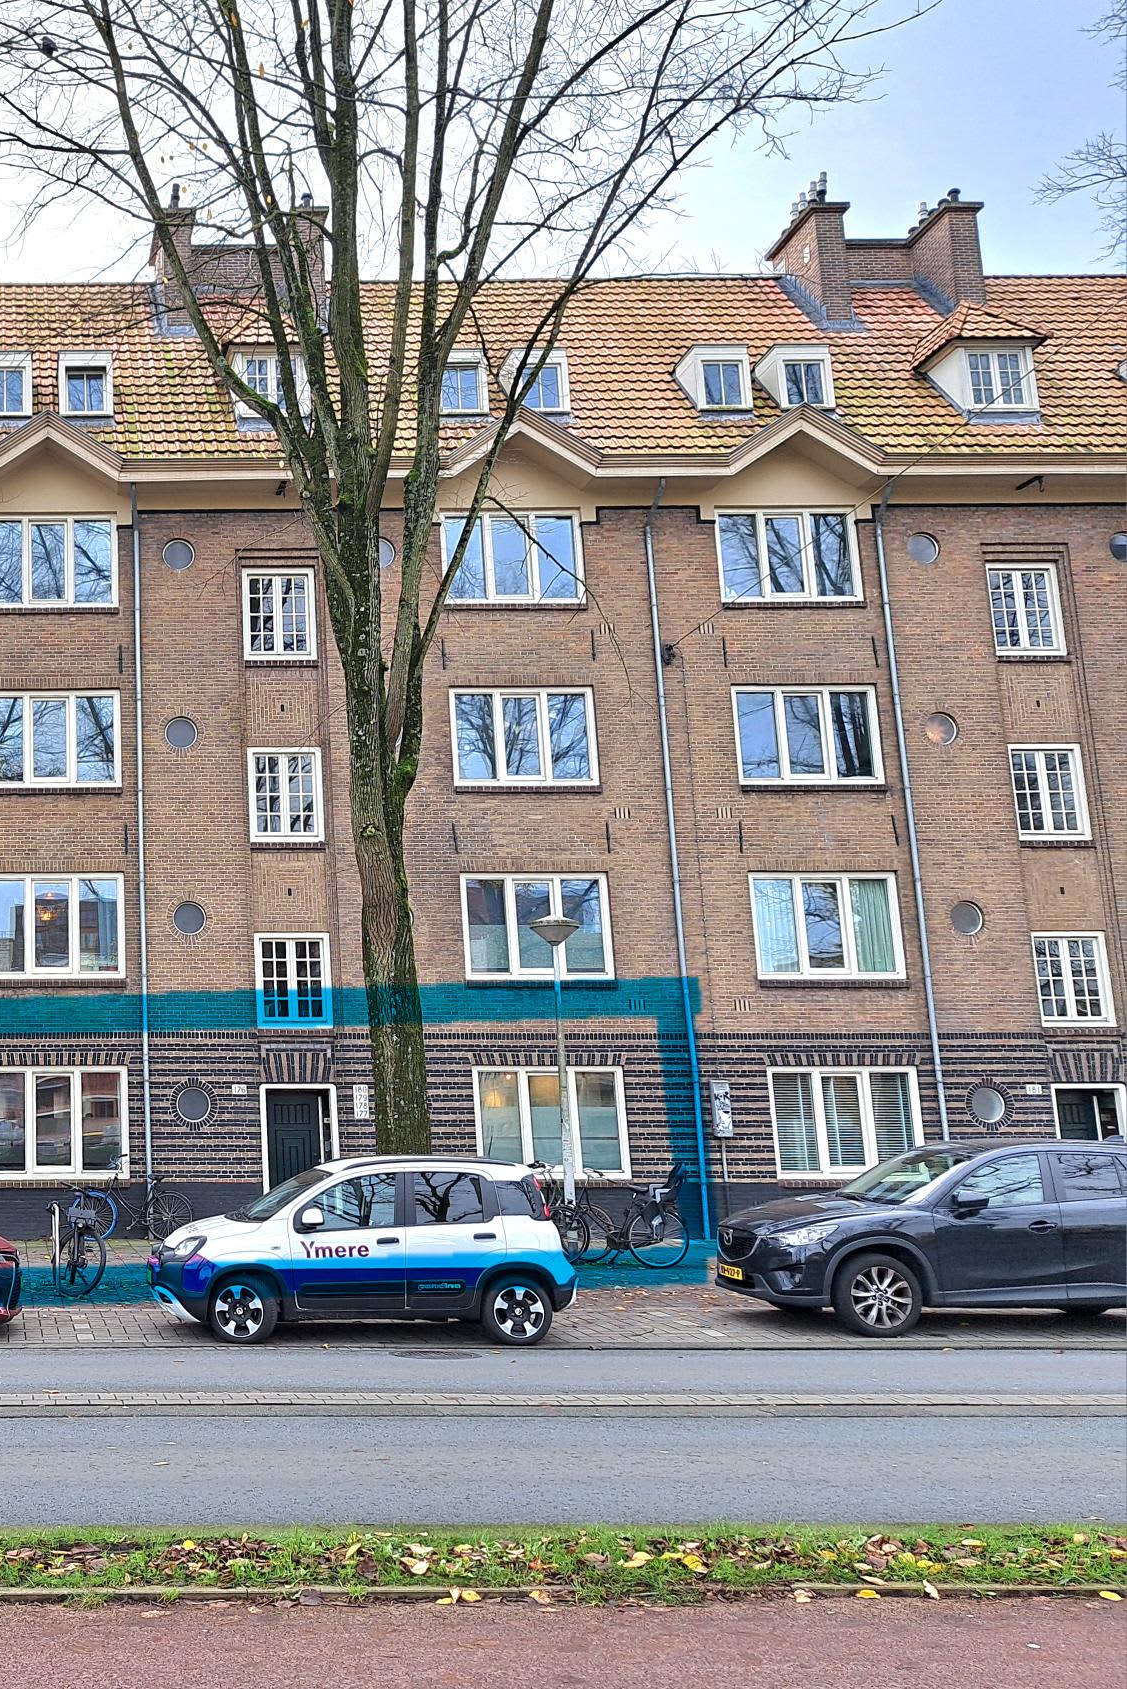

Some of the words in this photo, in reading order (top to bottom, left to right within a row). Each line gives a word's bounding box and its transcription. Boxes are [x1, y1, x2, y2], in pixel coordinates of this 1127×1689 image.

[233, 1086, 246, 1094] 176
[354, 1086, 367, 1094] 180
[355, 1094, 368, 1102] 179
[355, 1102, 368, 1110] 178
[356, 1110, 368, 1118] 177
[300, 1240, 370, 1259] Ymere
